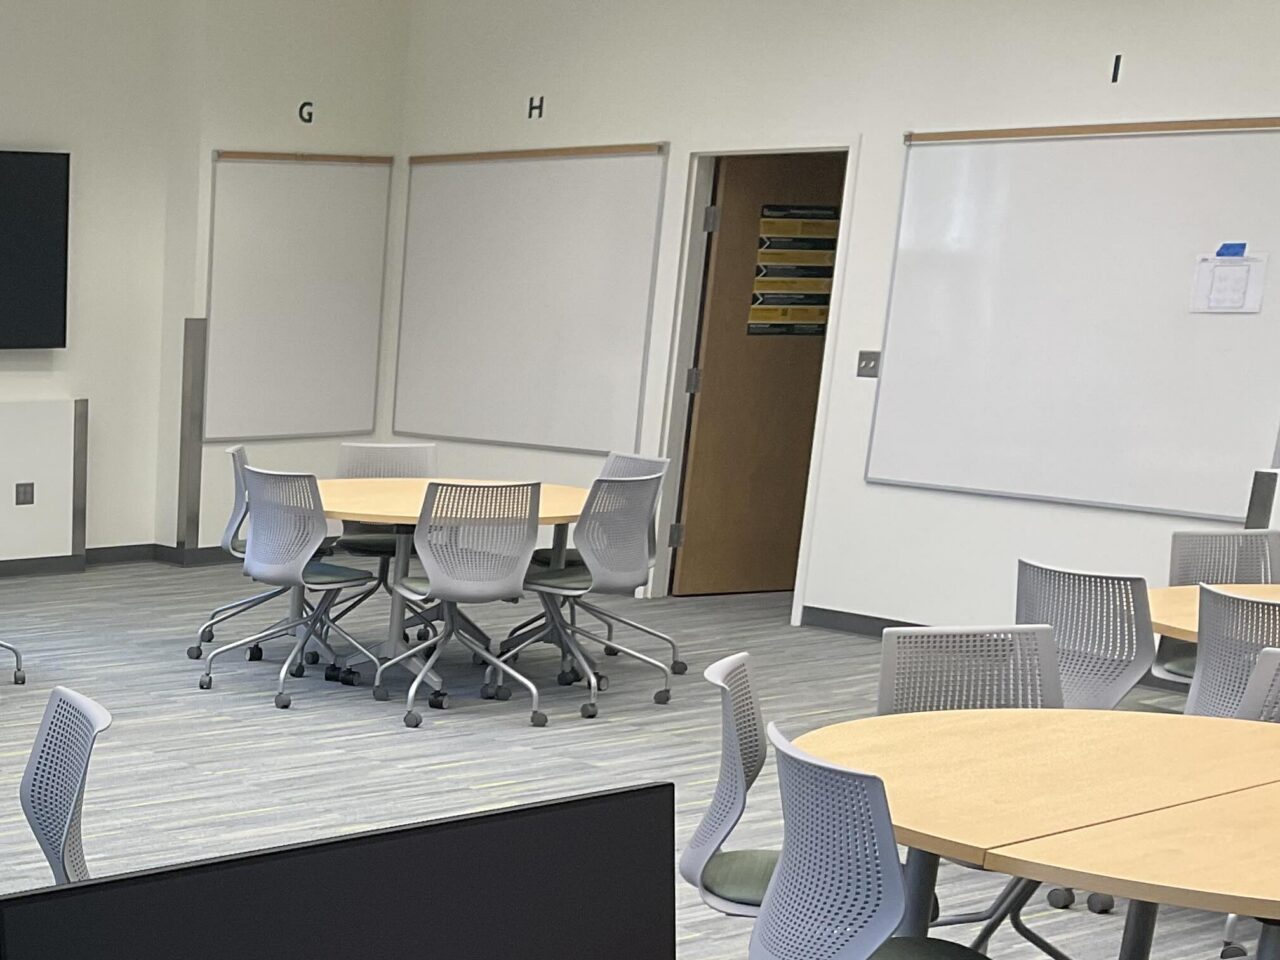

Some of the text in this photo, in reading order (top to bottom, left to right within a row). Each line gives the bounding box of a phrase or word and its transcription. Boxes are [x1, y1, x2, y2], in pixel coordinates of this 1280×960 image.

[1111, 54, 1122, 84] I
[298, 101, 314, 124] G
[527, 96, 545, 119] H
